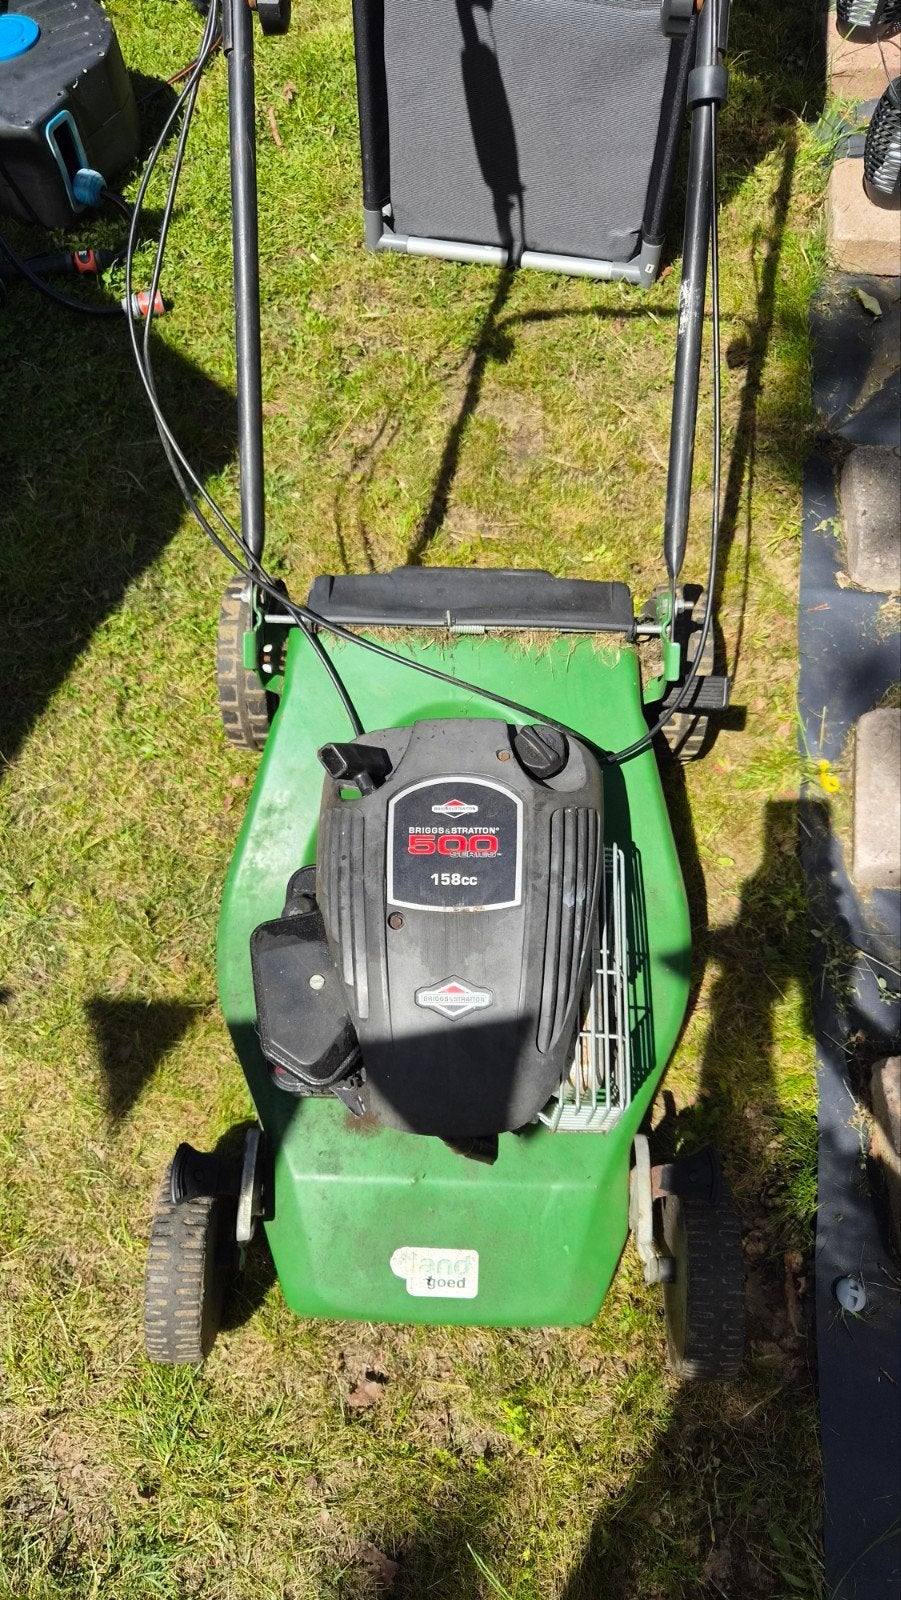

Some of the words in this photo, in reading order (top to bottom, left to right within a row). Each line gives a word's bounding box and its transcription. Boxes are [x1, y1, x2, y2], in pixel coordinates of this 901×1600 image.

[408, 835, 498, 855] 500
[431, 873, 478, 885] 158cc
[426, 1276, 466, 1290] goed
